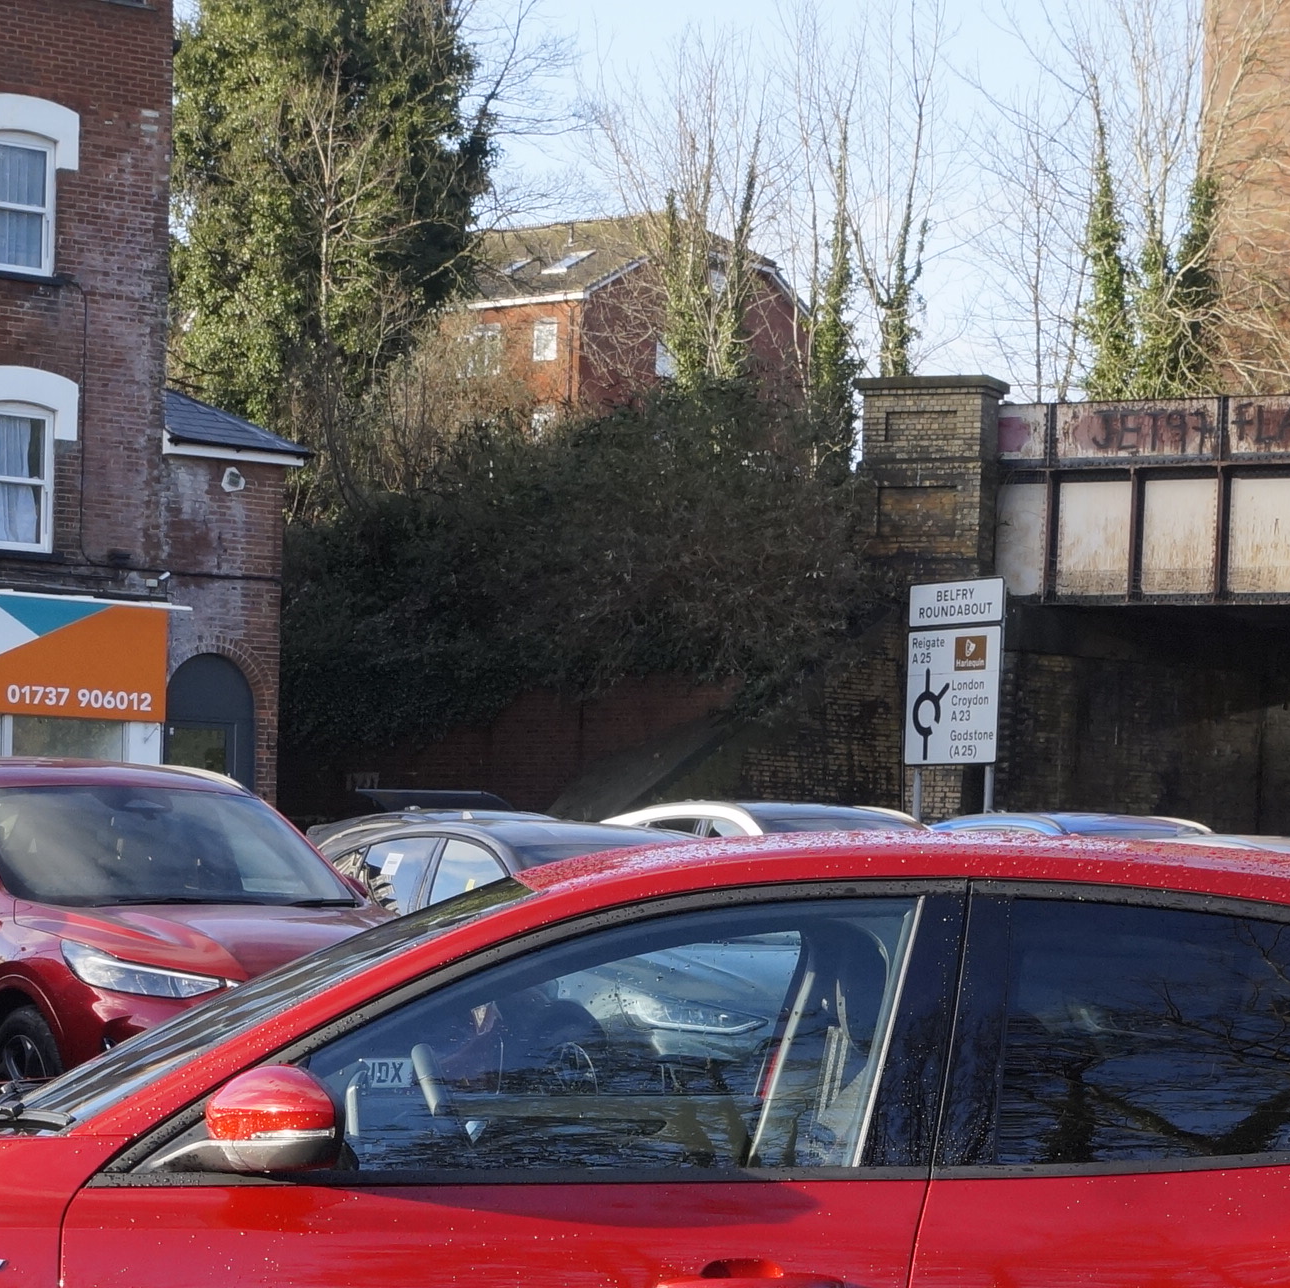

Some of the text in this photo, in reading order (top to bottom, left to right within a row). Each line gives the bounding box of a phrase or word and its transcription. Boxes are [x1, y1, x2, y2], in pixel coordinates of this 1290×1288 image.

[936, 588, 975, 602] BELFRY
[918, 602, 993, 619] ROUNDABOUT
[912, 637, 945, 650] Reigate
[951, 680, 985, 691] London
[7, 684, 152, 712] 01737 906012
[951, 694, 989, 707] Croydon
[950, 729, 994, 742] Godstone
